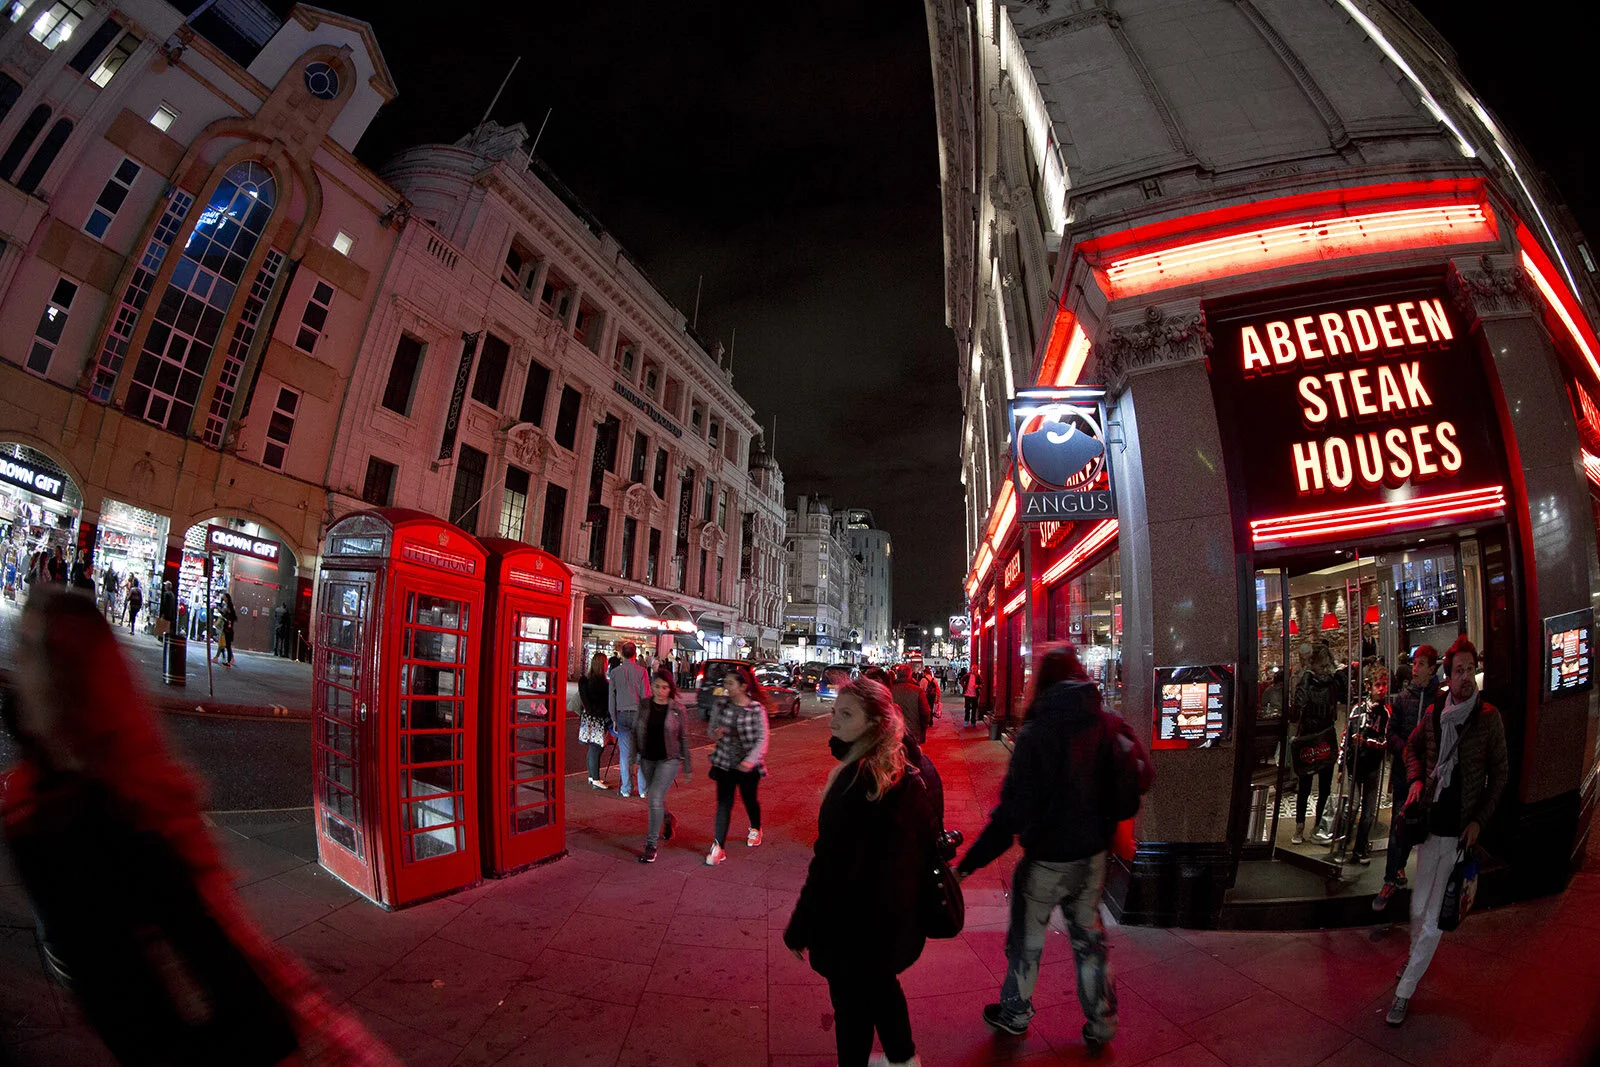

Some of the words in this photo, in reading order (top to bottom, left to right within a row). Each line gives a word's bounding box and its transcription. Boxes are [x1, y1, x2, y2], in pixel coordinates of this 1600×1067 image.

[1241, 298, 1455, 371] ABERDEEN
[1298, 361, 1434, 424] STEAK
[1292, 421, 1463, 493] HOUSES
[0, 459, 34, 485] ROWN
[34, 474, 61, 495] GIFT
[1026, 493, 1109, 513] ANGUS
[212, 530, 252, 552] CROWN
[252, 541, 277, 558] GIFT
[407, 544, 473, 572] TELEPHONE
